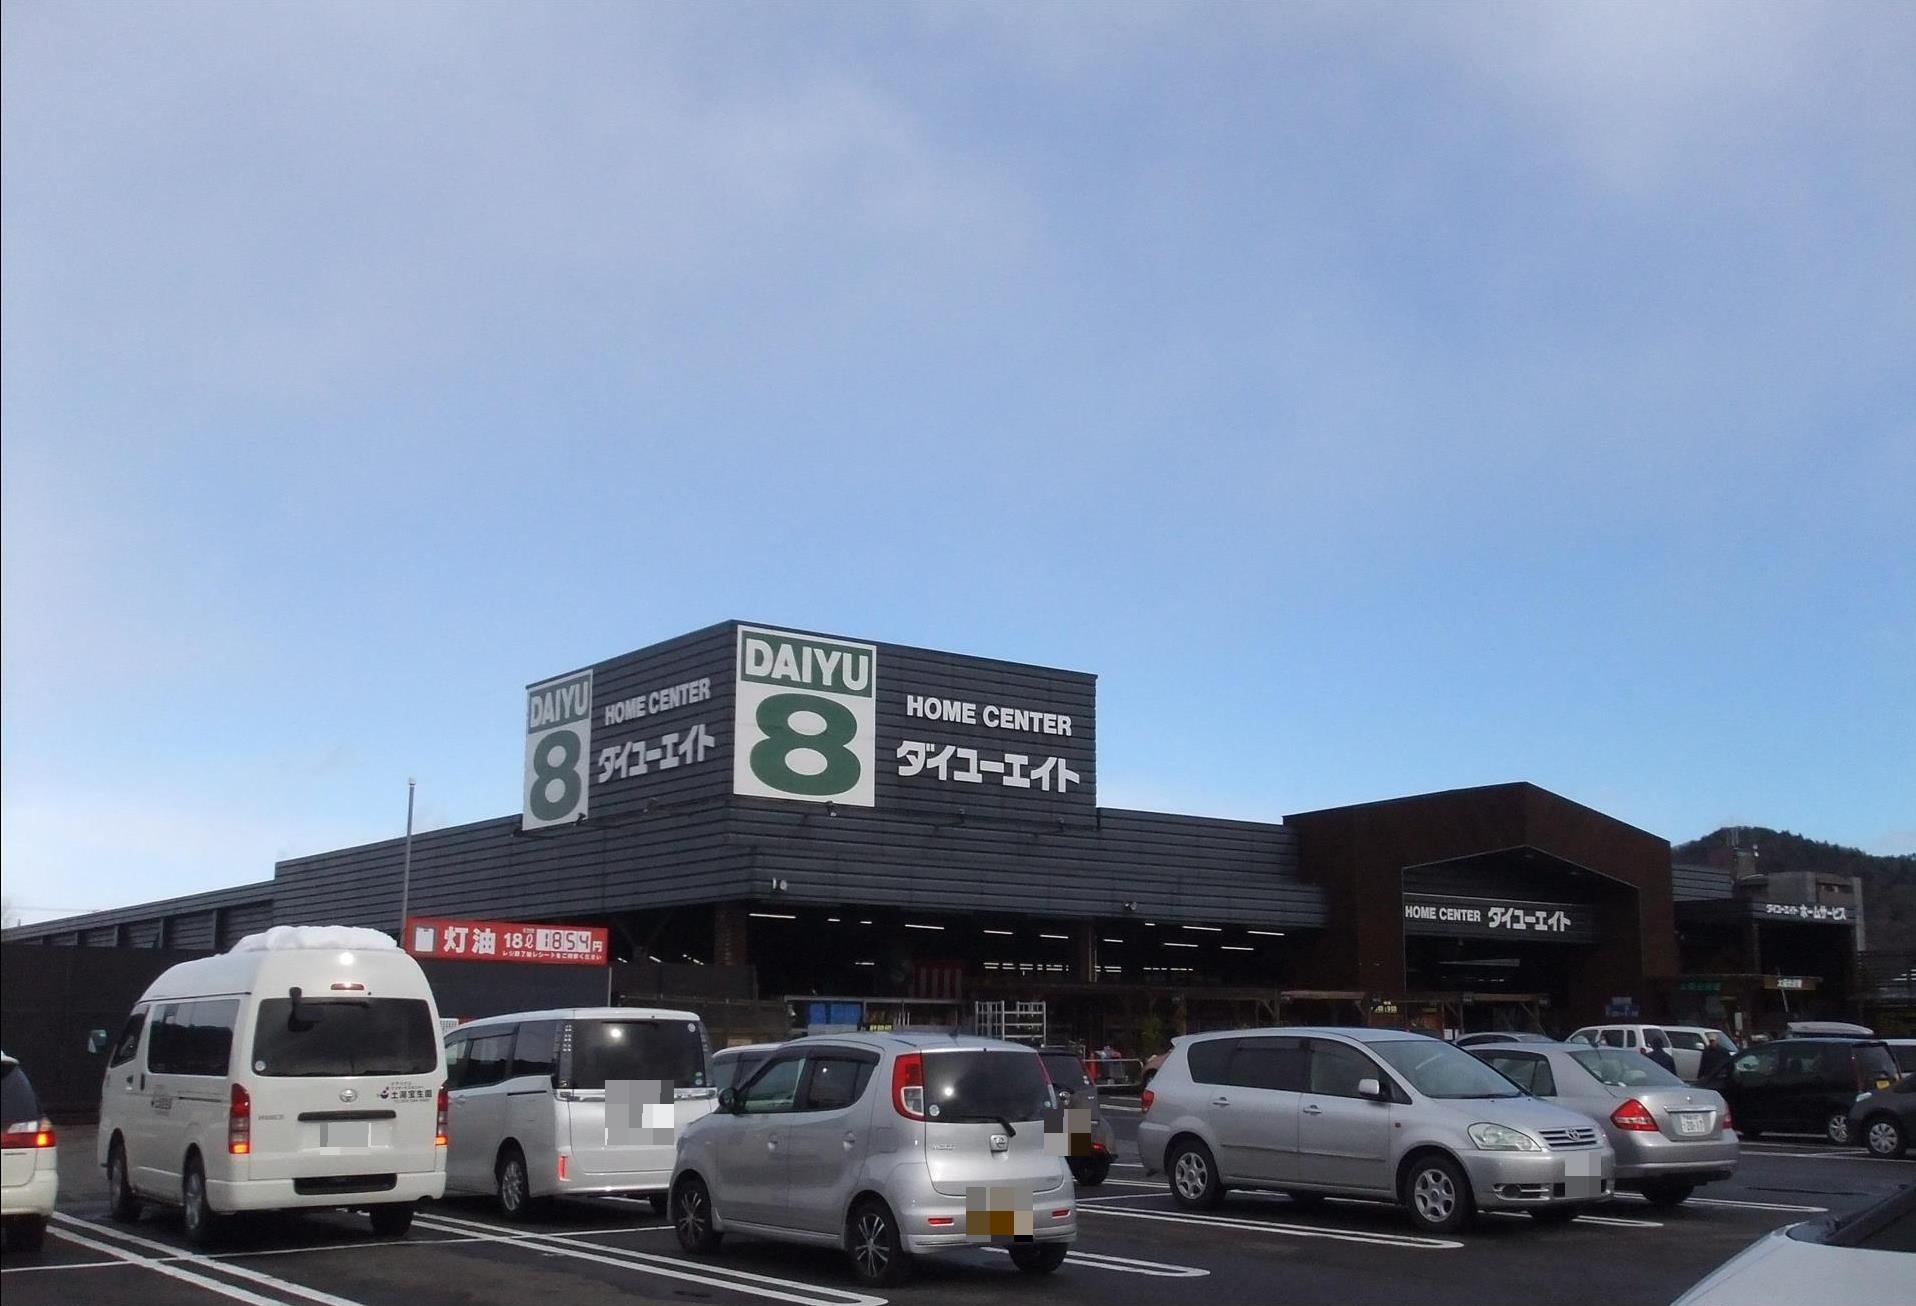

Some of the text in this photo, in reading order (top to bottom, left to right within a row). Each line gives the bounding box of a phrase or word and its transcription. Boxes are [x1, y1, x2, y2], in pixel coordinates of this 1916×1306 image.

[745, 638, 869, 691] DAIYU
[530, 681, 588, 728] DAIYU
[605, 677, 711, 726] HOME CENTER
[906, 695, 1072, 737] HOME CENTER
[598, 723, 715, 783] ダイユーエイト
[750, 693, 861, 796] 8
[896, 740, 1080, 793] ダイユーエイト
[530, 730, 581, 821] 8
[1405, 905, 1481, 922] HOME CENTER
[443, 925, 496, 955] 灯油
